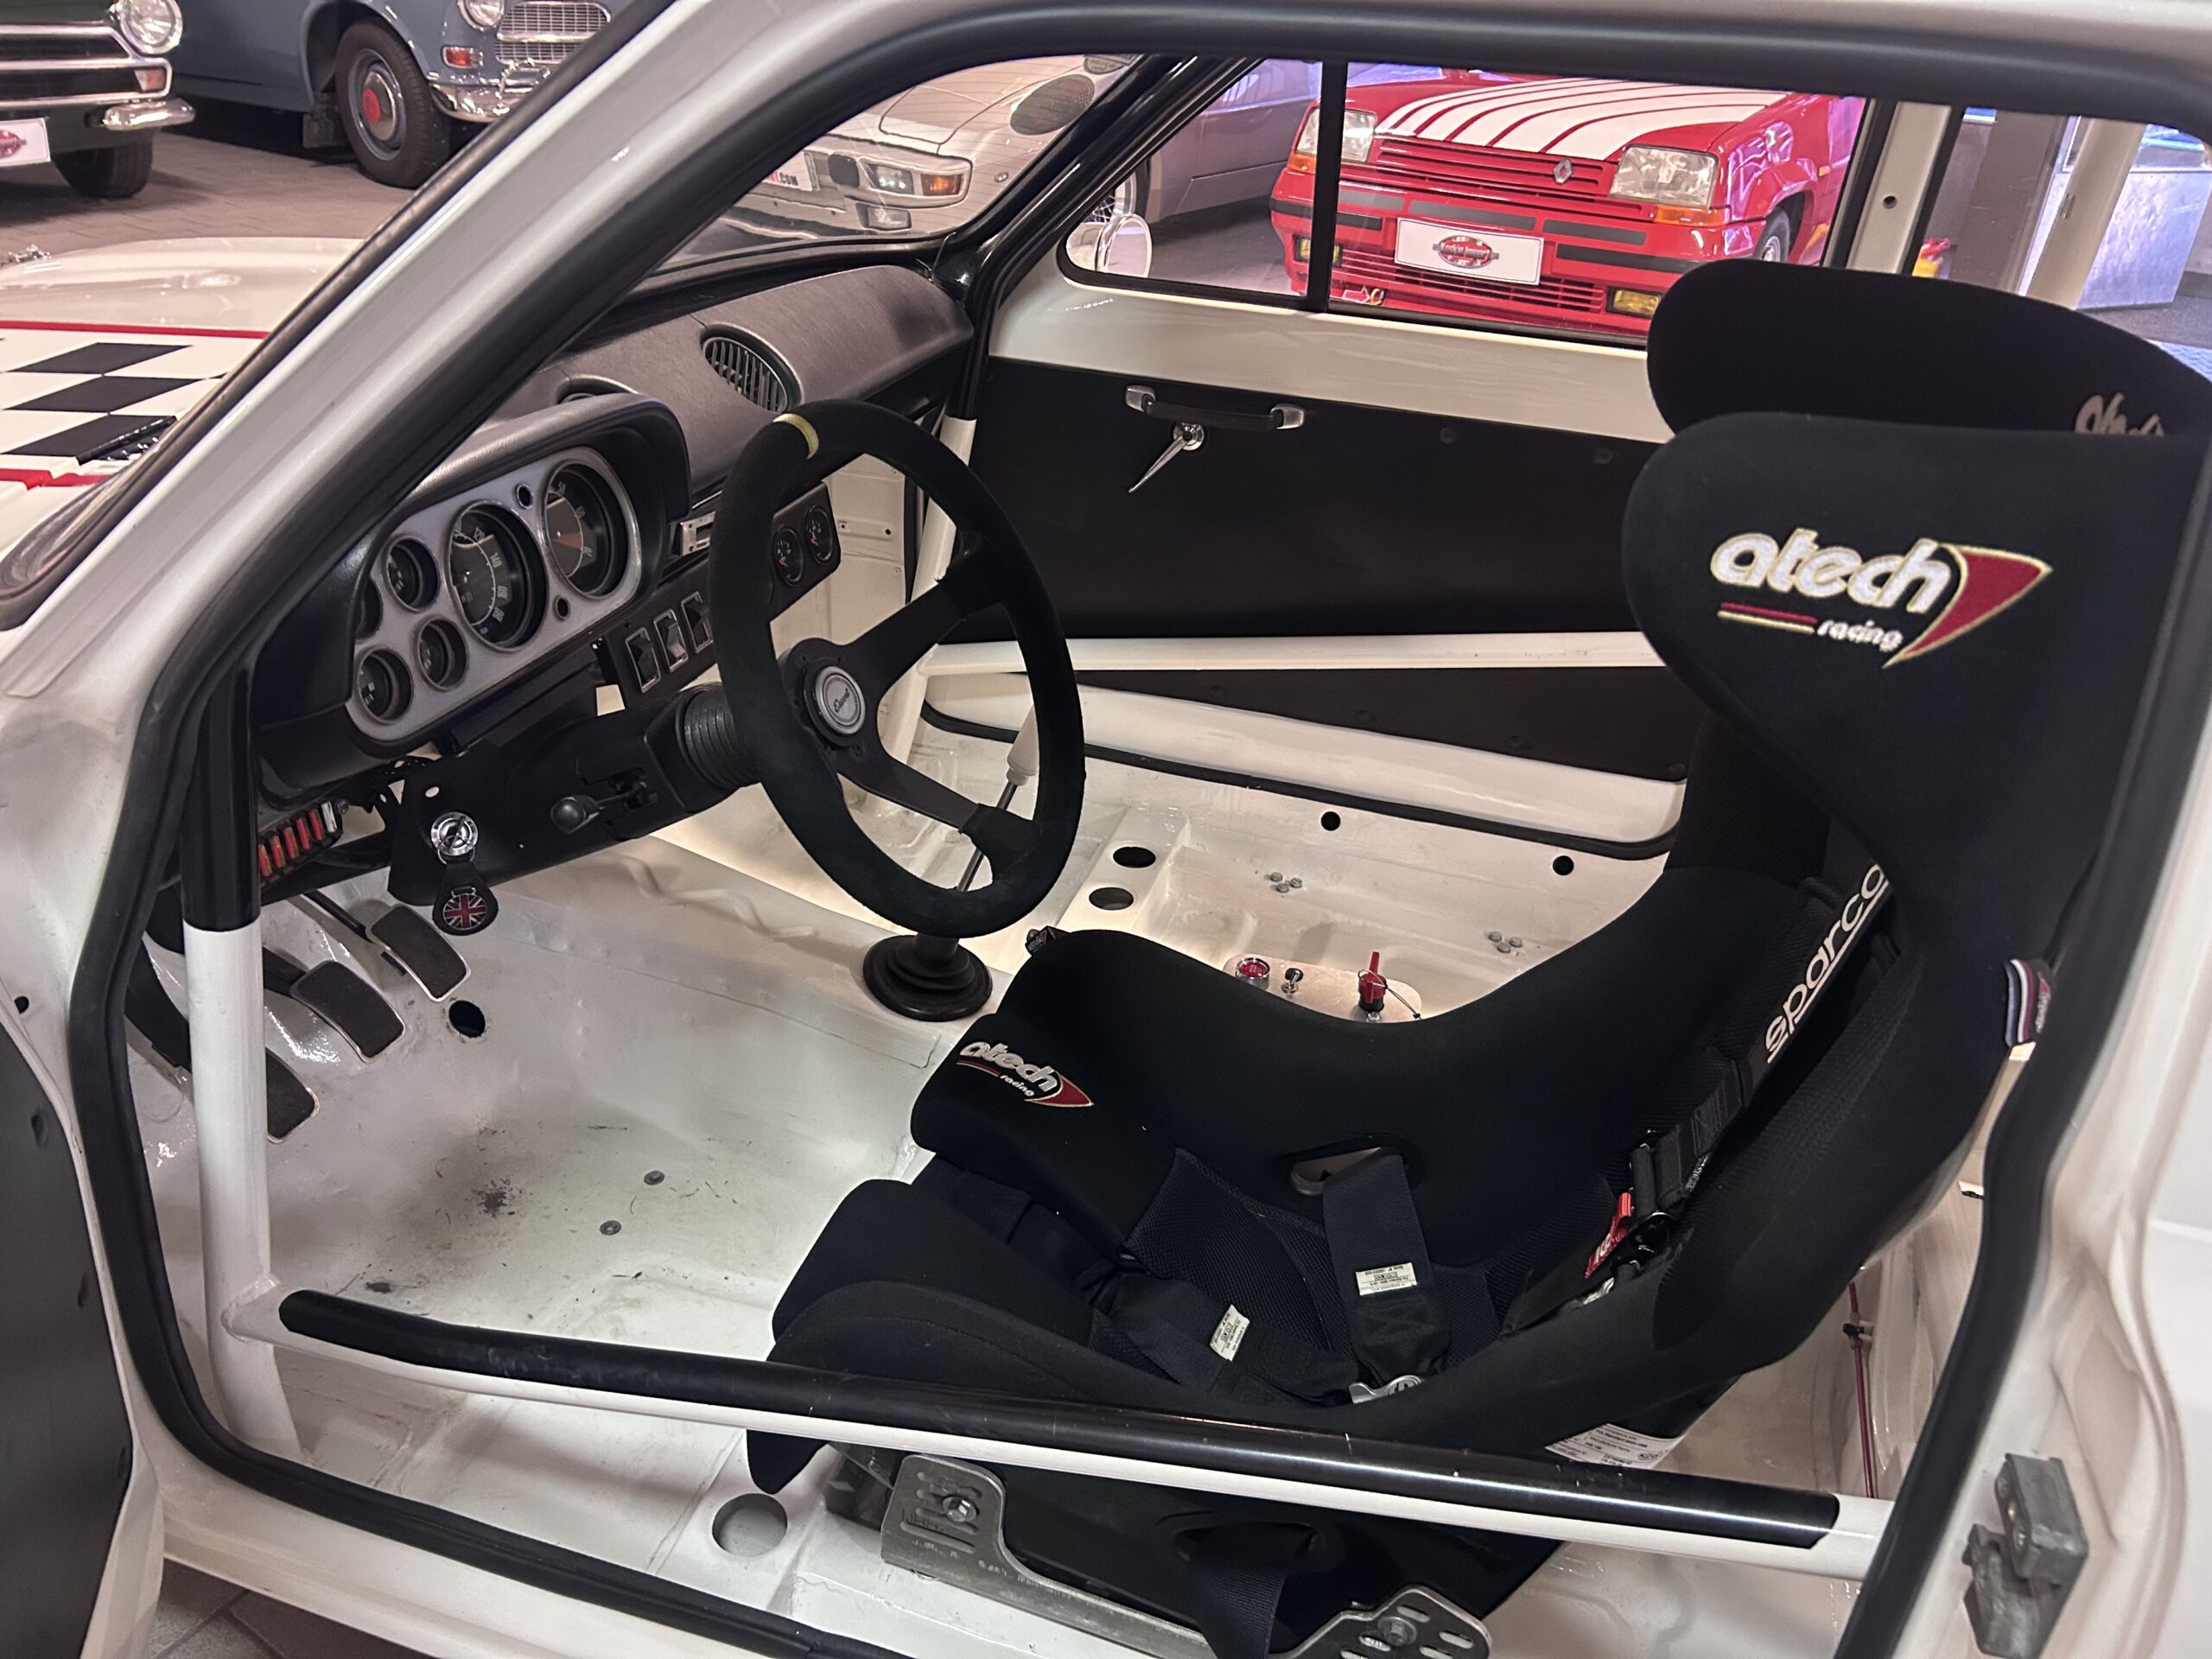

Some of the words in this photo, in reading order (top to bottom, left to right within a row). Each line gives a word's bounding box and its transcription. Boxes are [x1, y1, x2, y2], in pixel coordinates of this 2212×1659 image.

[490, 552, 503, 568] 140
[1710, 528, 1951, 614] atech
[1817, 620, 1903, 652] racing
[1765, 864, 1885, 1052] sparco
[959, 1041, 1058, 1092] atech
